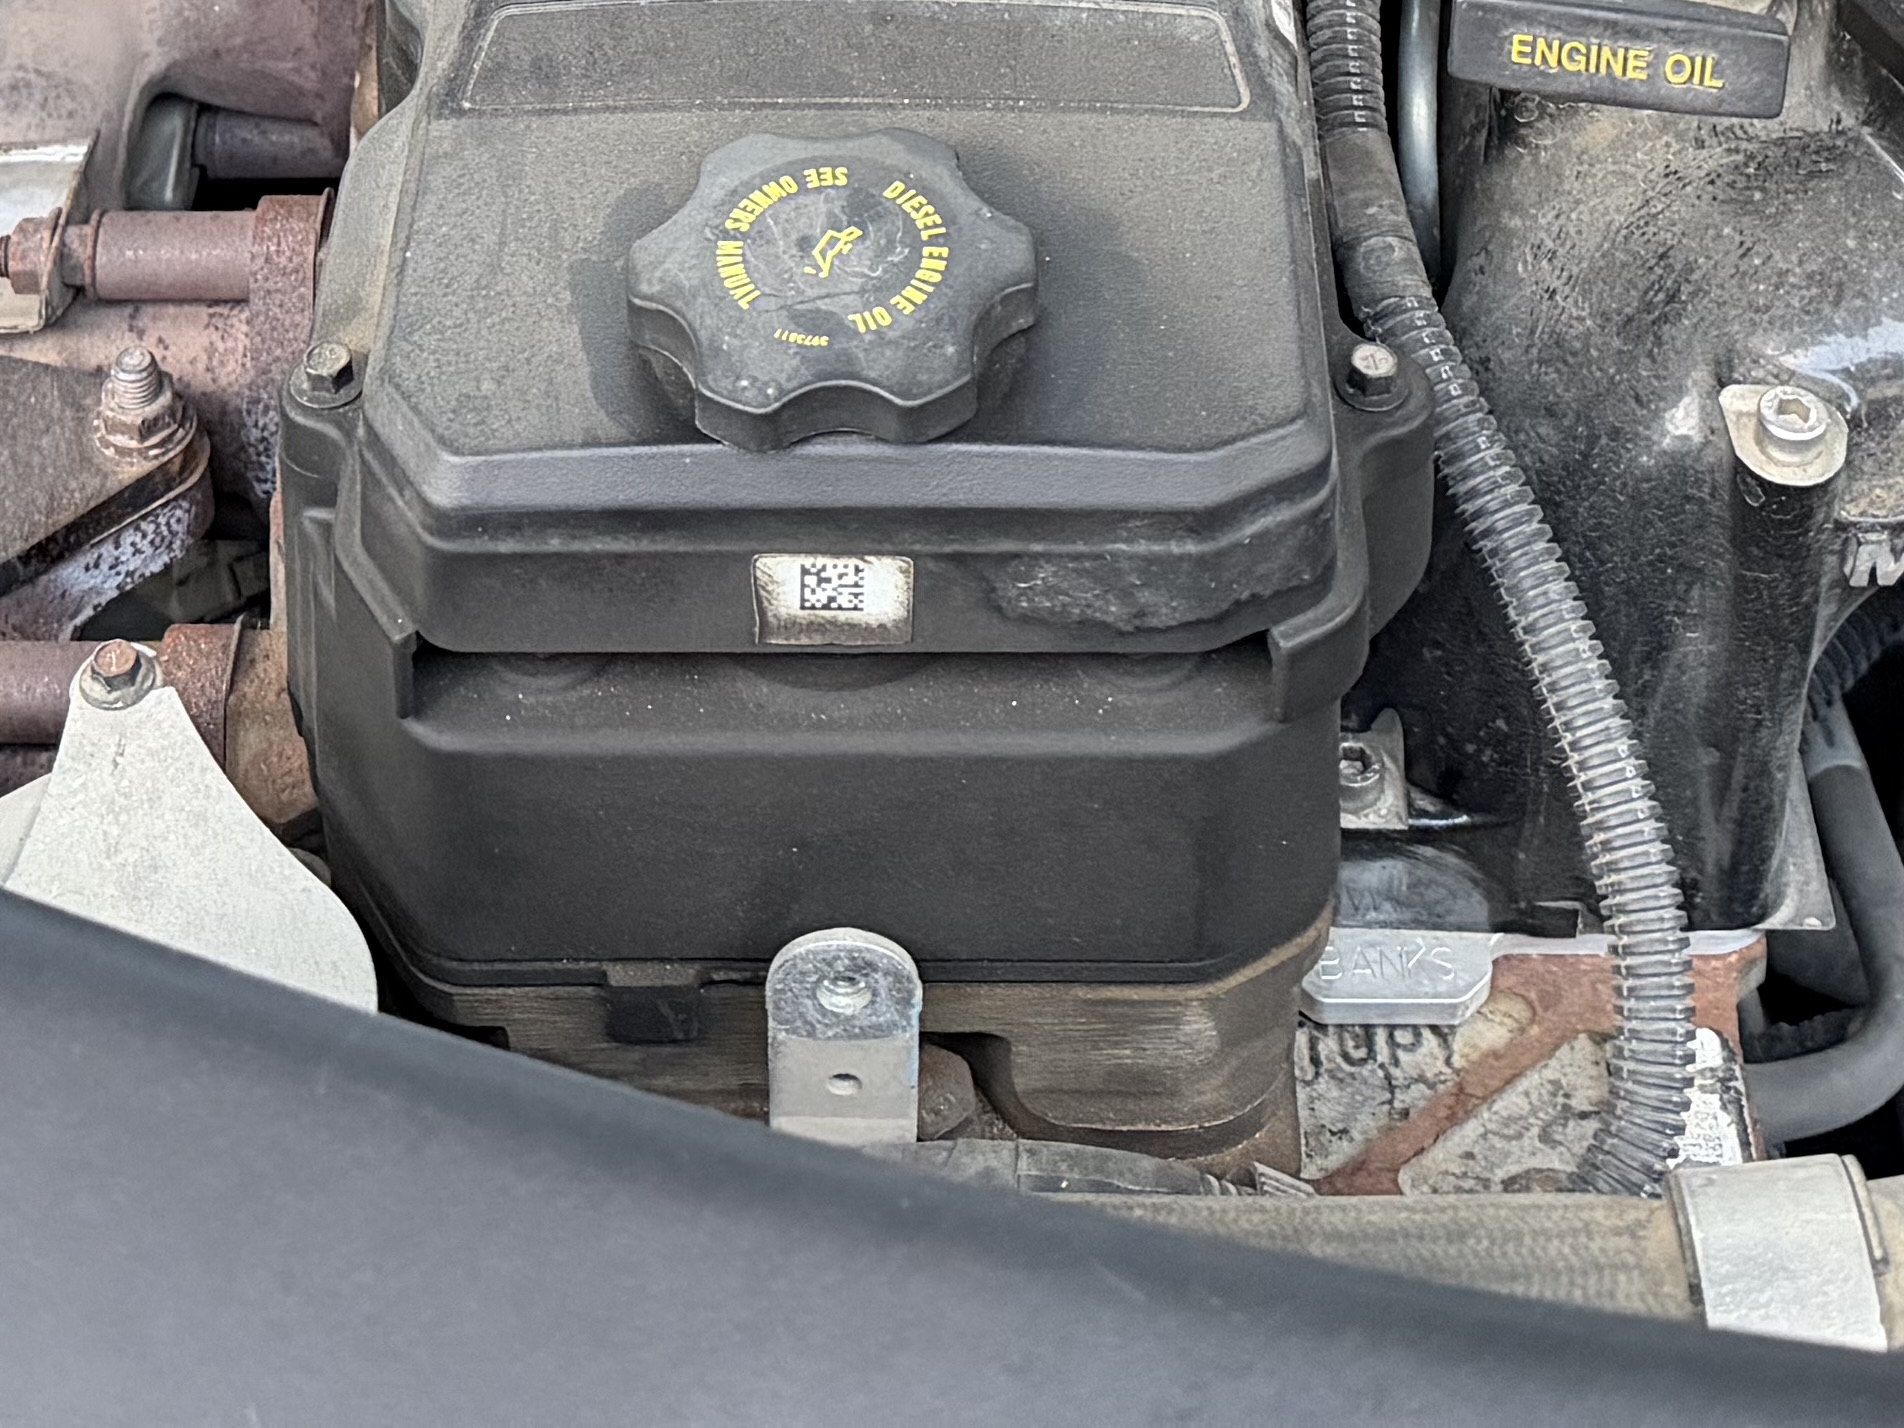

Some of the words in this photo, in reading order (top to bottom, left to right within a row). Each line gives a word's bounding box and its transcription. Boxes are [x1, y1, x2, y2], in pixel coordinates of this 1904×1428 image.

[1509, 32, 1651, 82] ENGINE
[1664, 44, 1725, 91] OIL
[724, 175, 799, 233] OWNERS
[802, 166, 849, 189] SEE
[882, 180, 948, 242] DIESEL
[715, 239, 763, 312] MANUAL
[888, 245, 950, 316] ENGINE
[847, 305, 893, 335] OIL
